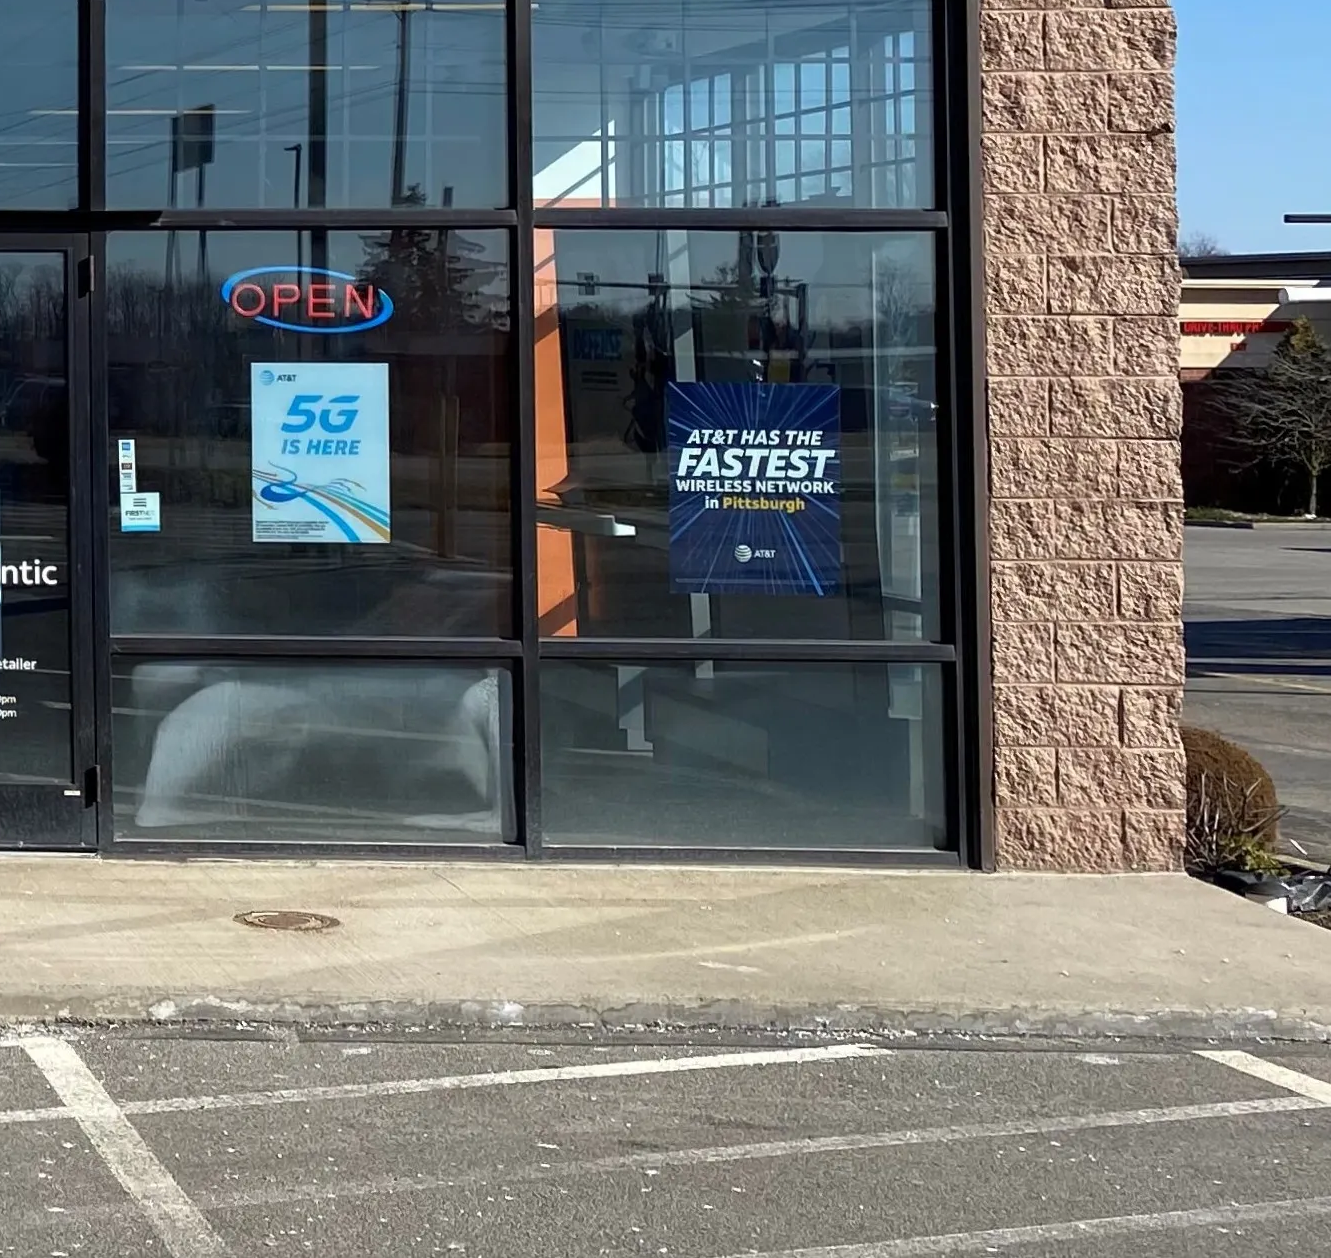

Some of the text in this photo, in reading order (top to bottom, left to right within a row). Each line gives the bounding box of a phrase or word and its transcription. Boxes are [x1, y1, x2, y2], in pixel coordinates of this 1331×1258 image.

[231, 283, 375, 319] OPEN
[277, 374, 297, 382] AT&T
[281, 395, 361, 434] 5G
[687, 429, 823, 446] AT&T HAS THE
[281, 439, 362, 455] IS HERE
[677, 448, 836, 478] FASTEST
[676, 479, 835, 493] WIRELESS NETWORK
[705, 496, 805, 513] in Pittsburgh
[754, 549, 776, 558] AT&T
